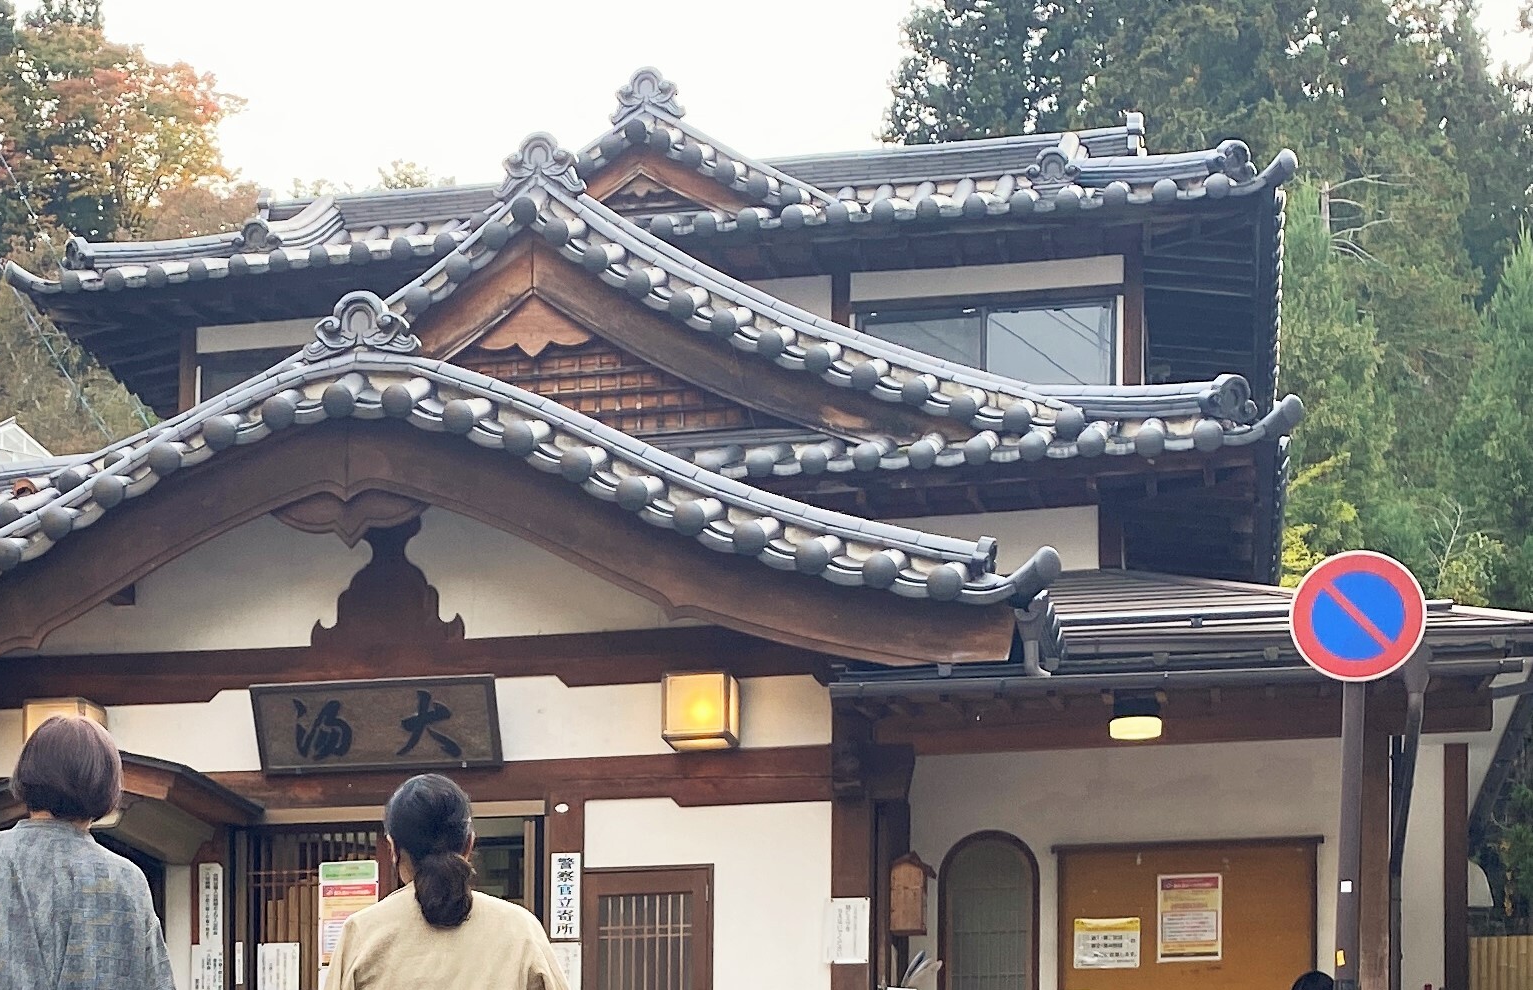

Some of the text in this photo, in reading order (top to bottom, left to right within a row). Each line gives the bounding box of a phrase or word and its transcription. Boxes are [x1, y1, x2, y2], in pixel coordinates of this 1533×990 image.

[556, 857, 574, 935] 警察官立寄所
